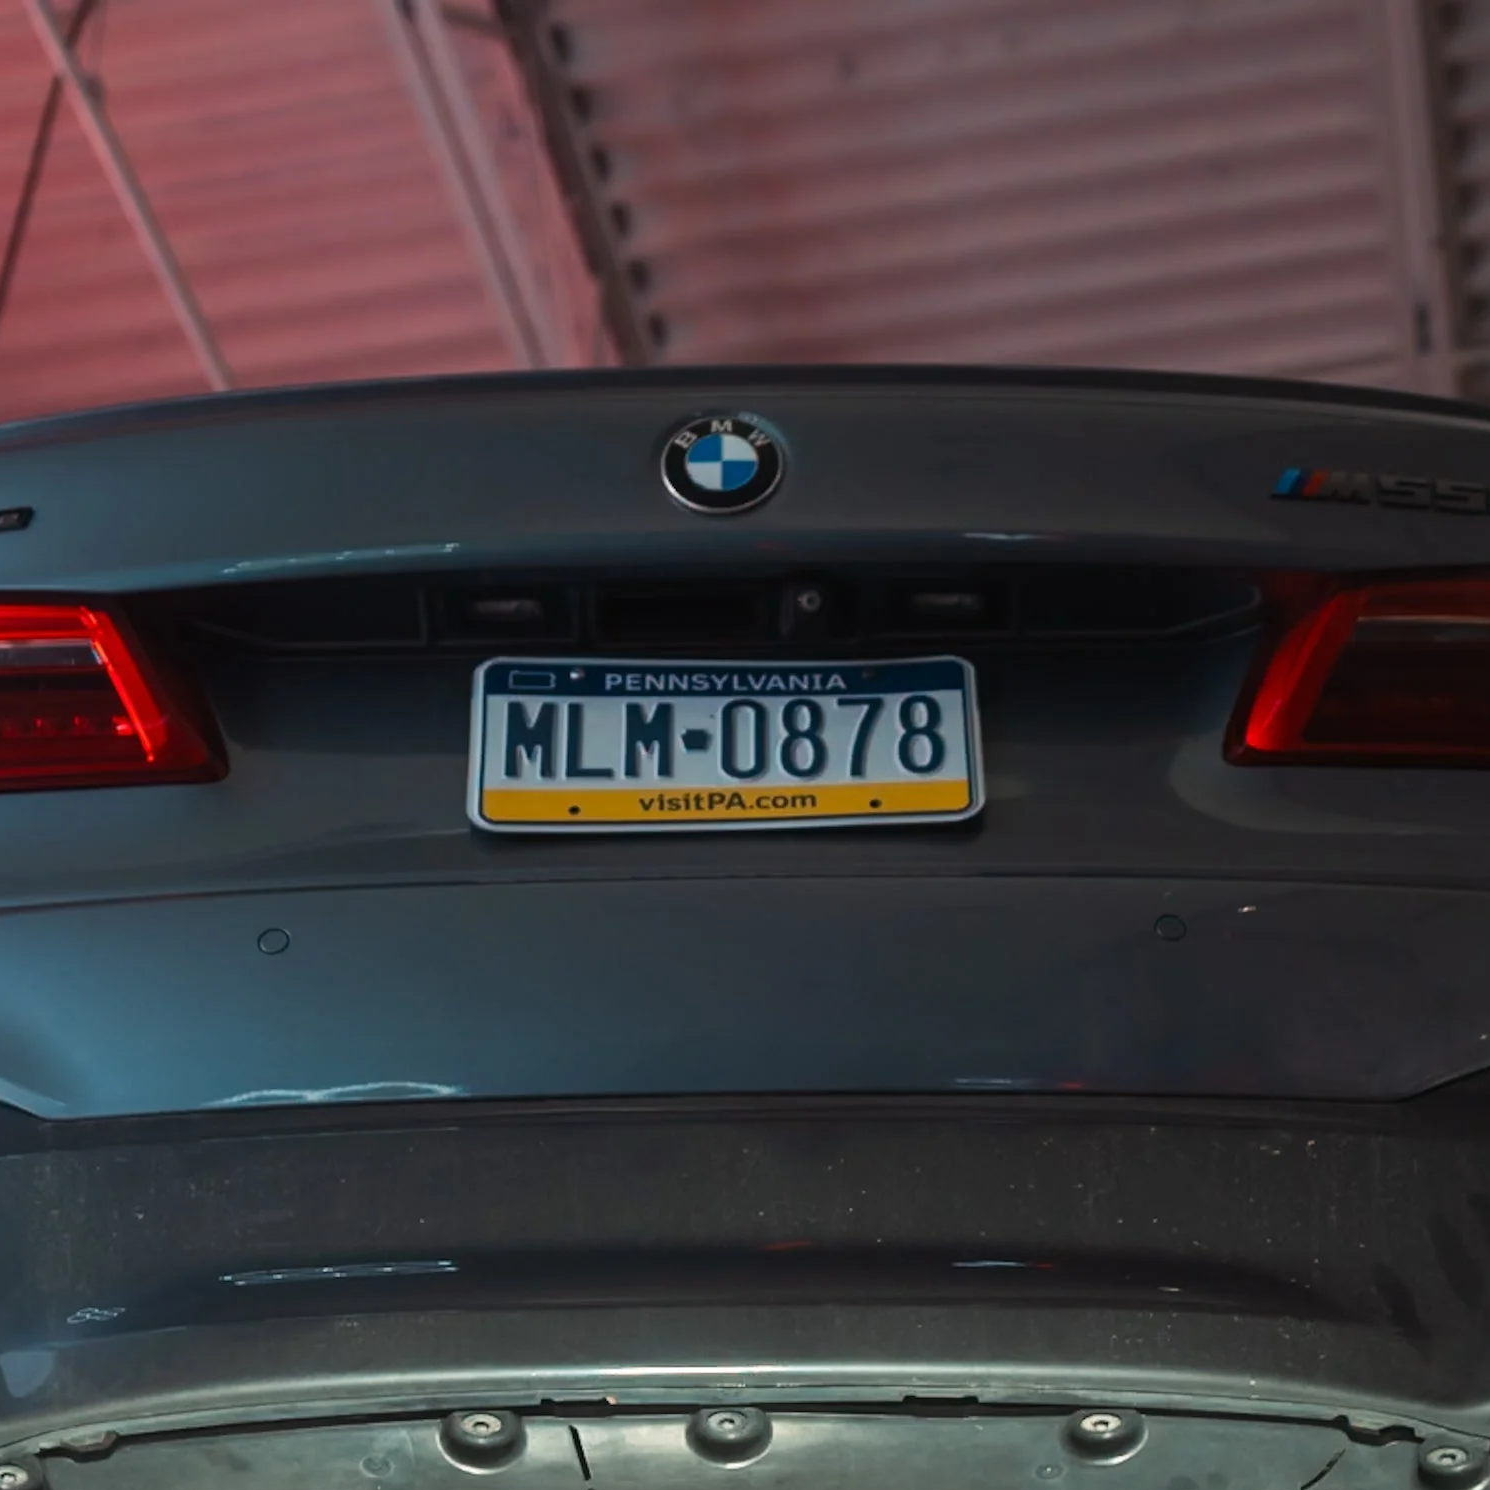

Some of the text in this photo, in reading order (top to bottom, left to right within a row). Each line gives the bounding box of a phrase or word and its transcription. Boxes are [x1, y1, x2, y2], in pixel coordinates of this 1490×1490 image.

[673, 419, 771, 448] BMW
[604, 673, 848, 692] PENNSYLVANIA
[638, 791, 818, 812] visitPA.com
